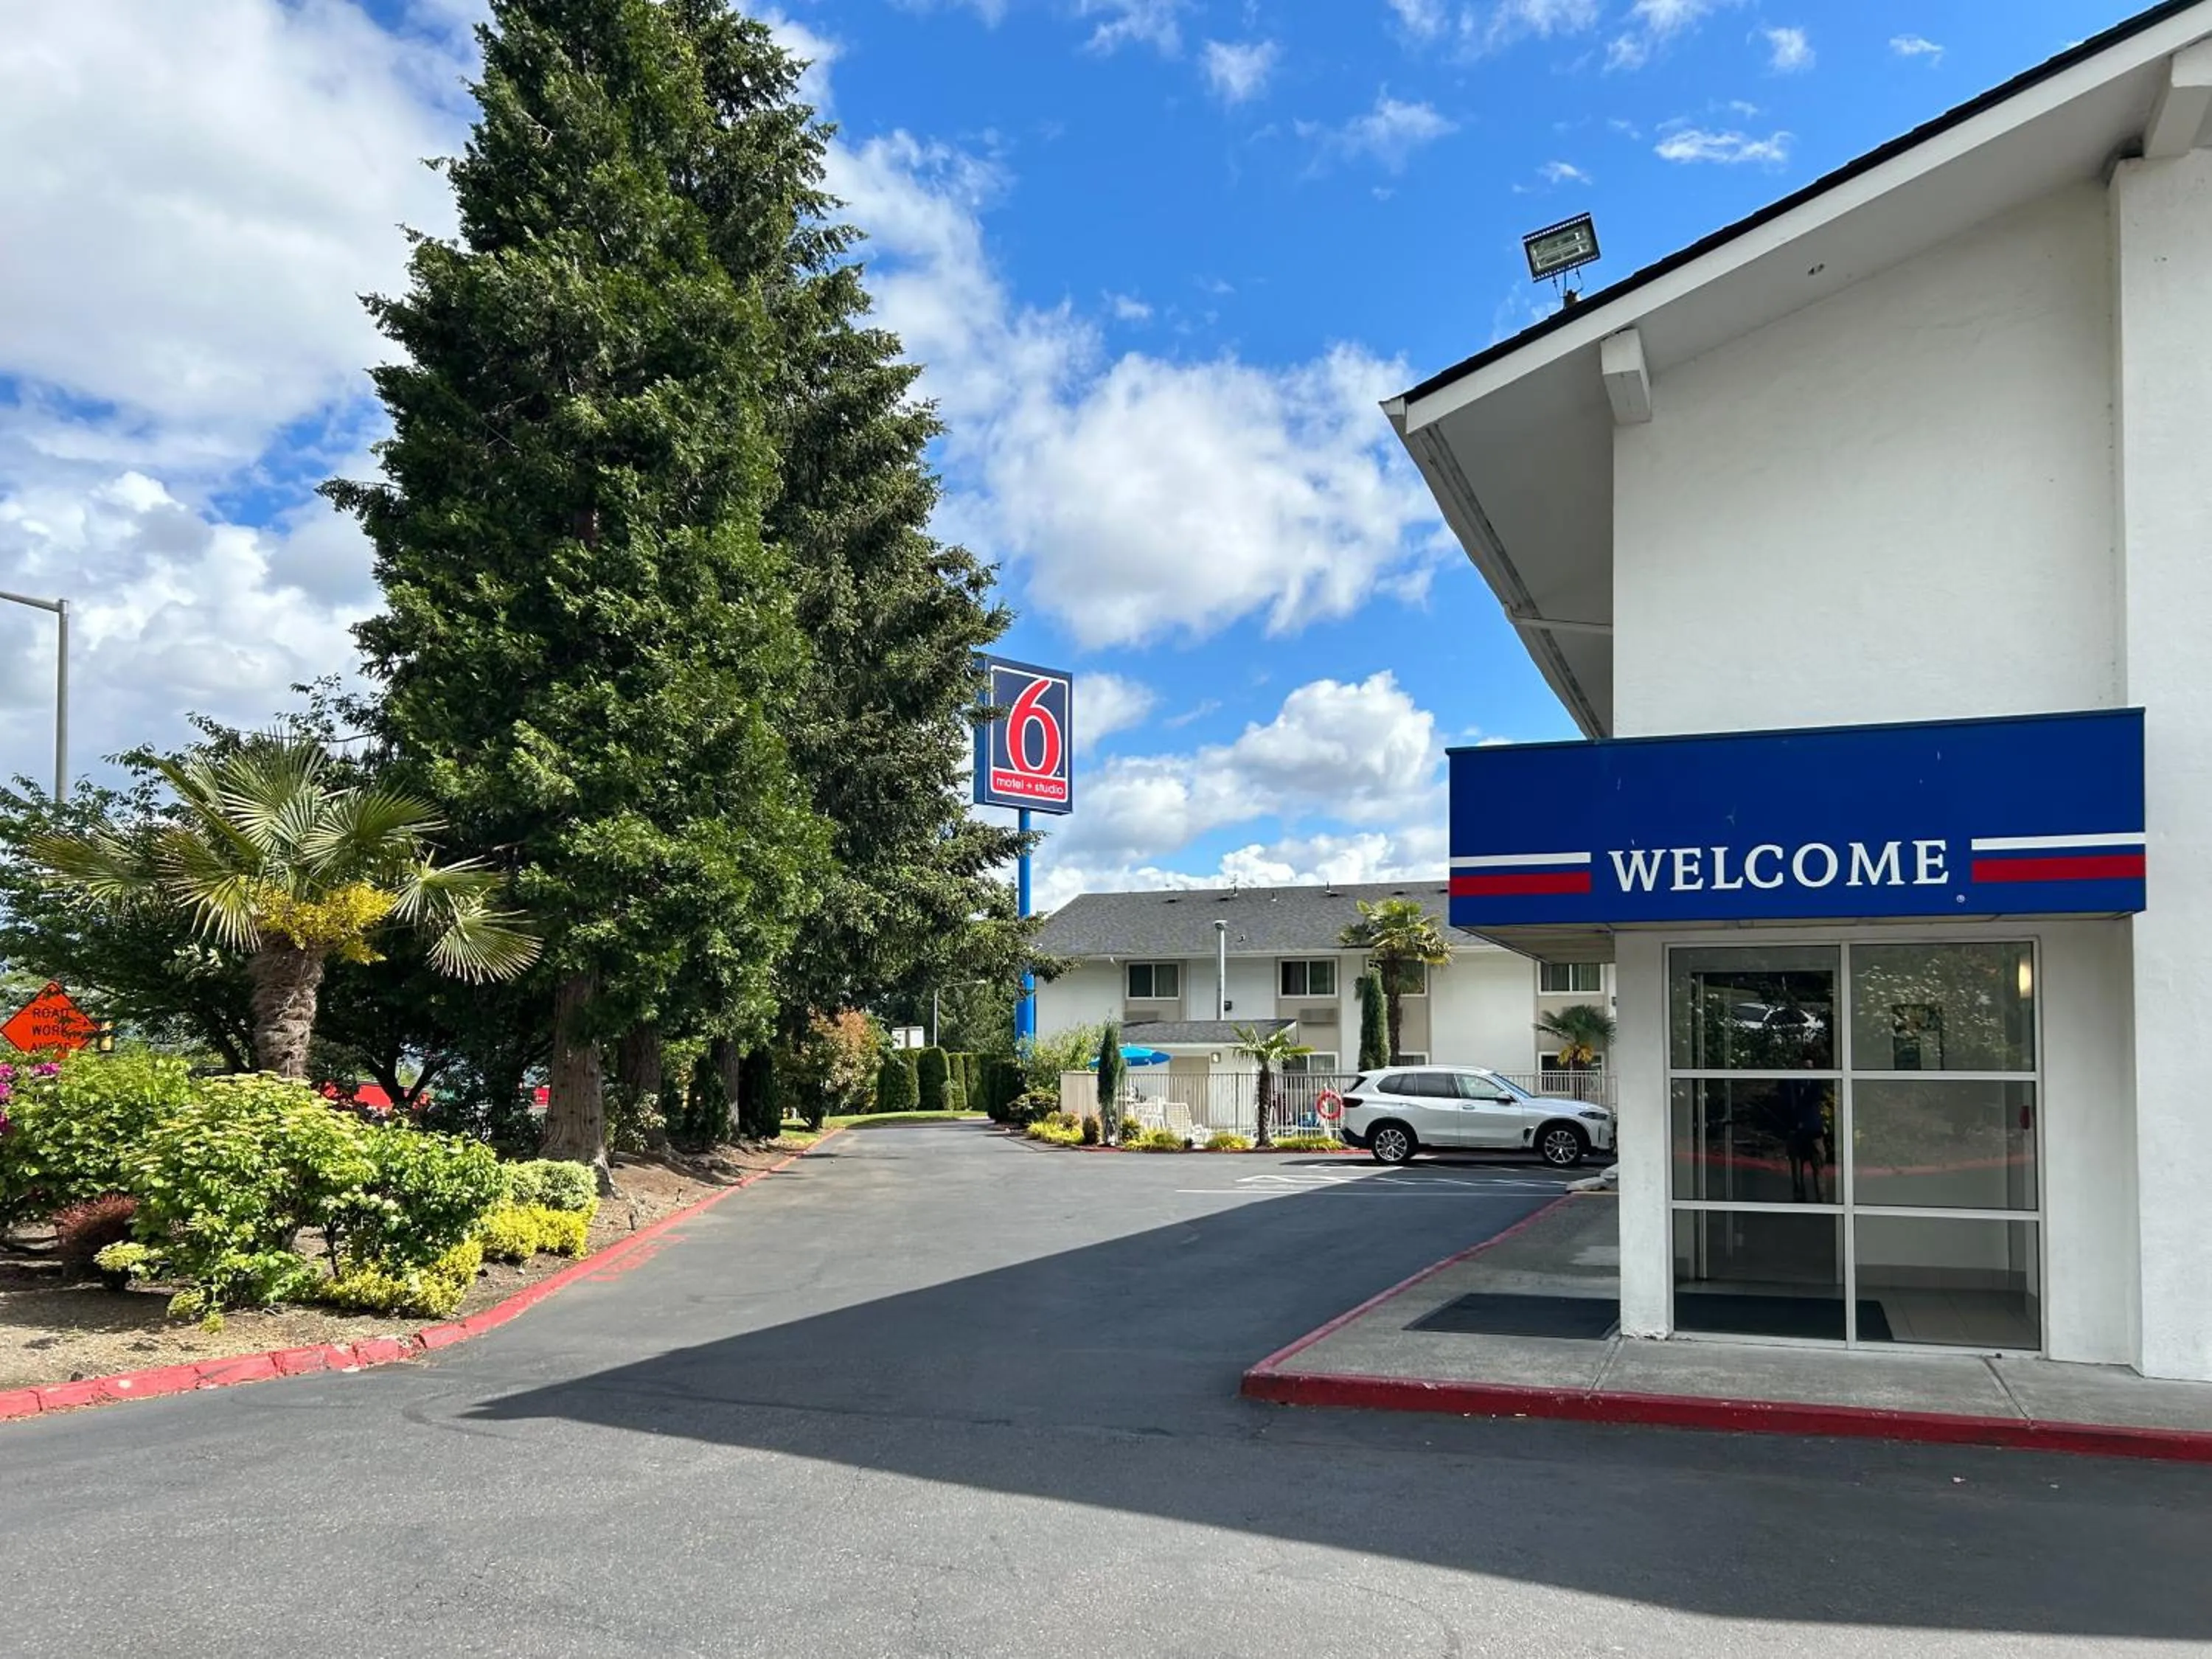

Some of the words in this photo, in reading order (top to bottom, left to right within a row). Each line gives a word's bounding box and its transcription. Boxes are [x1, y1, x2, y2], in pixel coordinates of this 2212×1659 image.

[1006, 678, 1062, 776] 6
[996, 777, 1024, 790] motel
[1034, 782, 1063, 795] studio
[1608, 840, 1949, 891] WELCOME
[32, 1008, 69, 1018] ROAD
[32, 1025, 69, 1037] WORK
